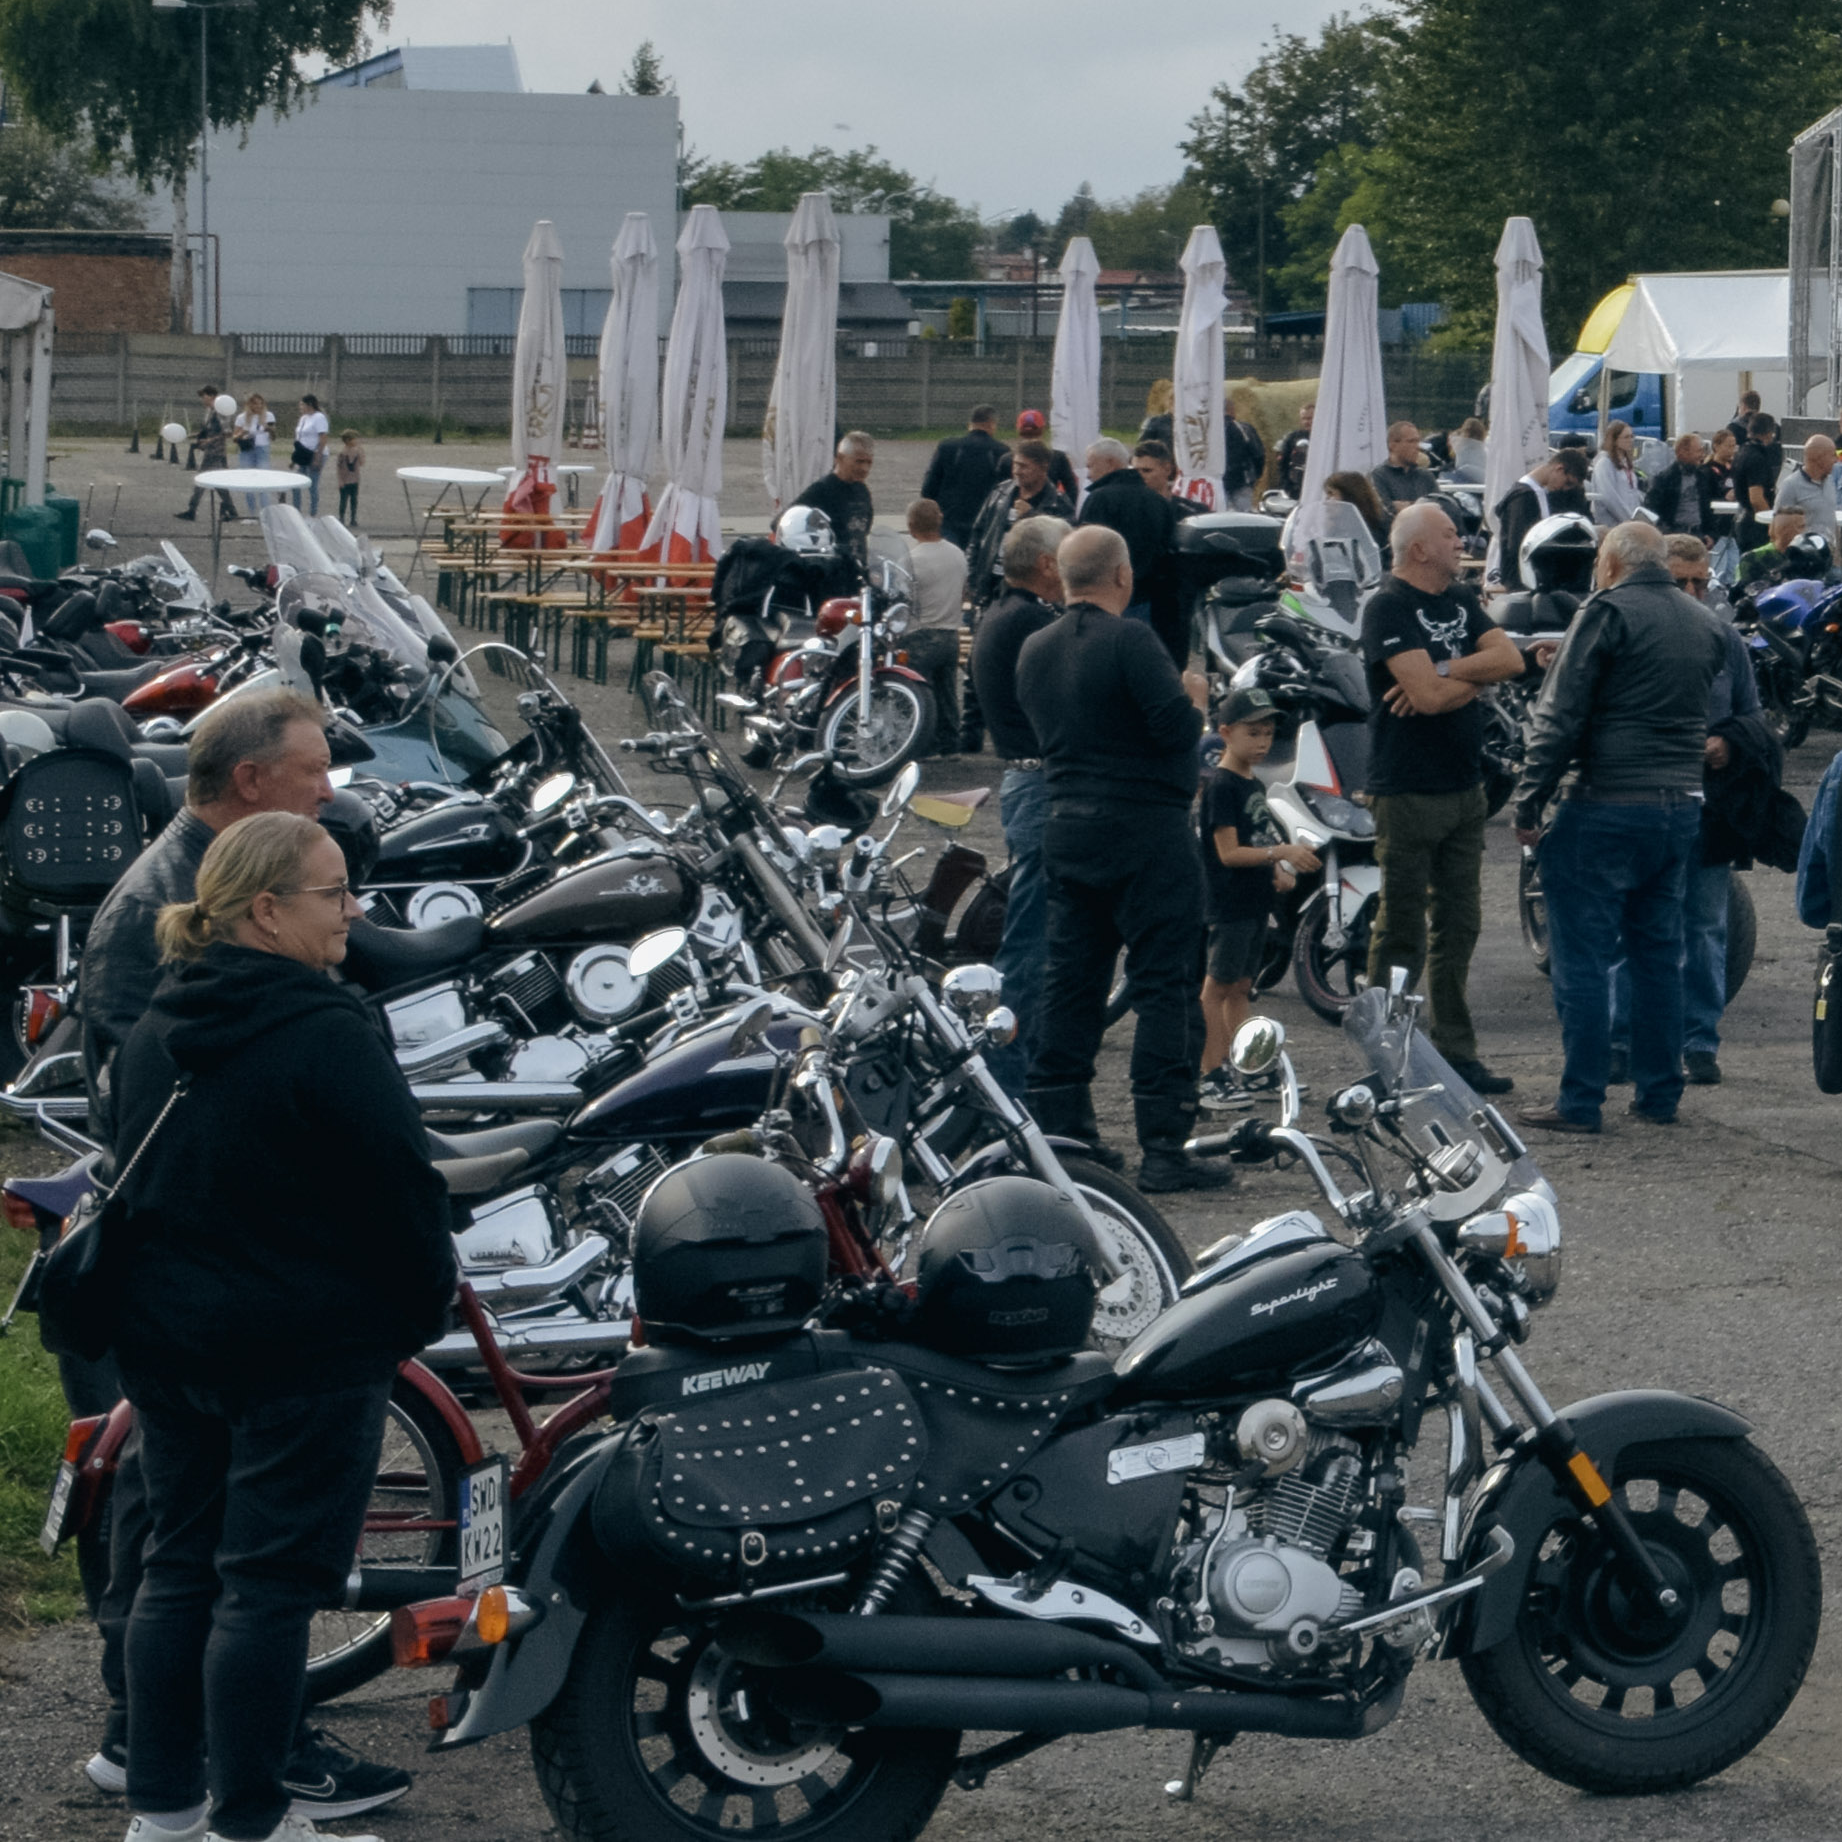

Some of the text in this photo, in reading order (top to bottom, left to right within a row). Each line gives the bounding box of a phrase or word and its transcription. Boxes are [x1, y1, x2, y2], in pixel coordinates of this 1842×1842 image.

[1250, 1277, 1339, 1316] Superlight
[682, 1361, 771, 1396] KEEWAY
[471, 1476, 496, 1518] SWD
